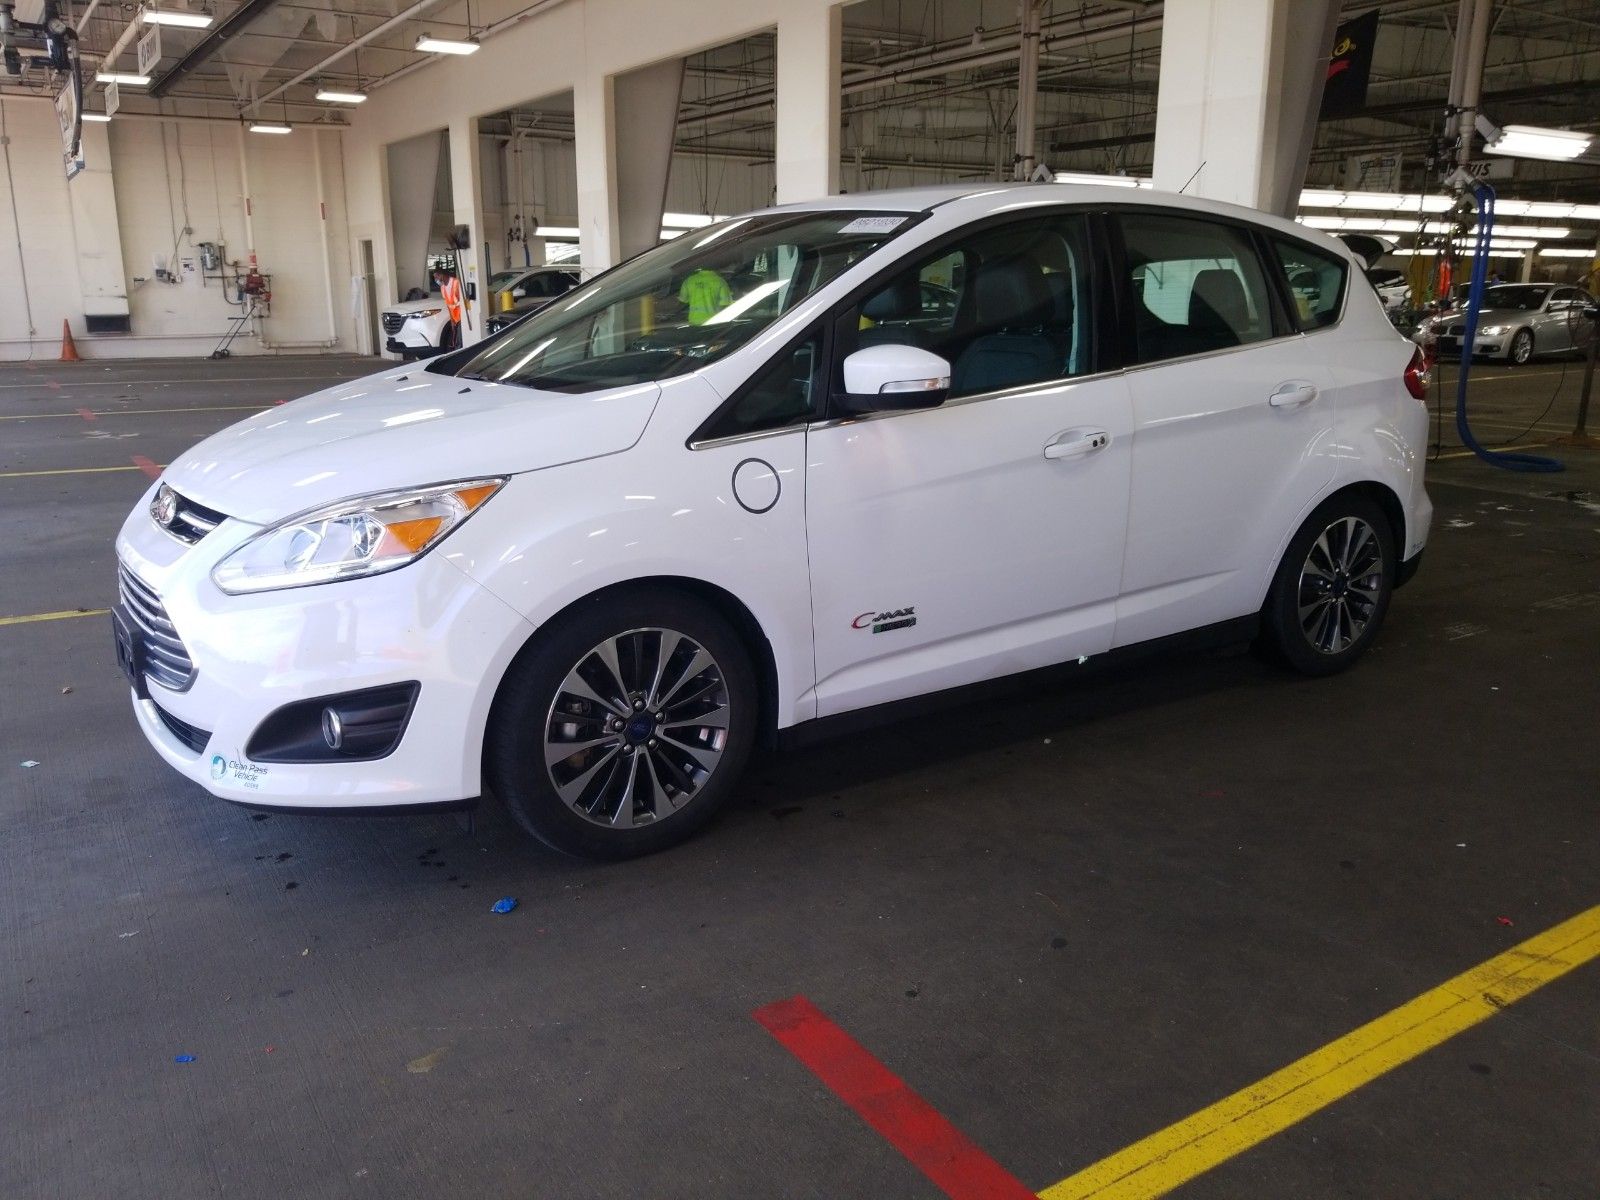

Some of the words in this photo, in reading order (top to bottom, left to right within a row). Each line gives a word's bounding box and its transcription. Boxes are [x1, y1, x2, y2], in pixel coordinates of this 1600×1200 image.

[229, 760, 248, 771] Clean
[249, 763, 268, 775] Pass
[234, 770, 258, 781] Vehicle
